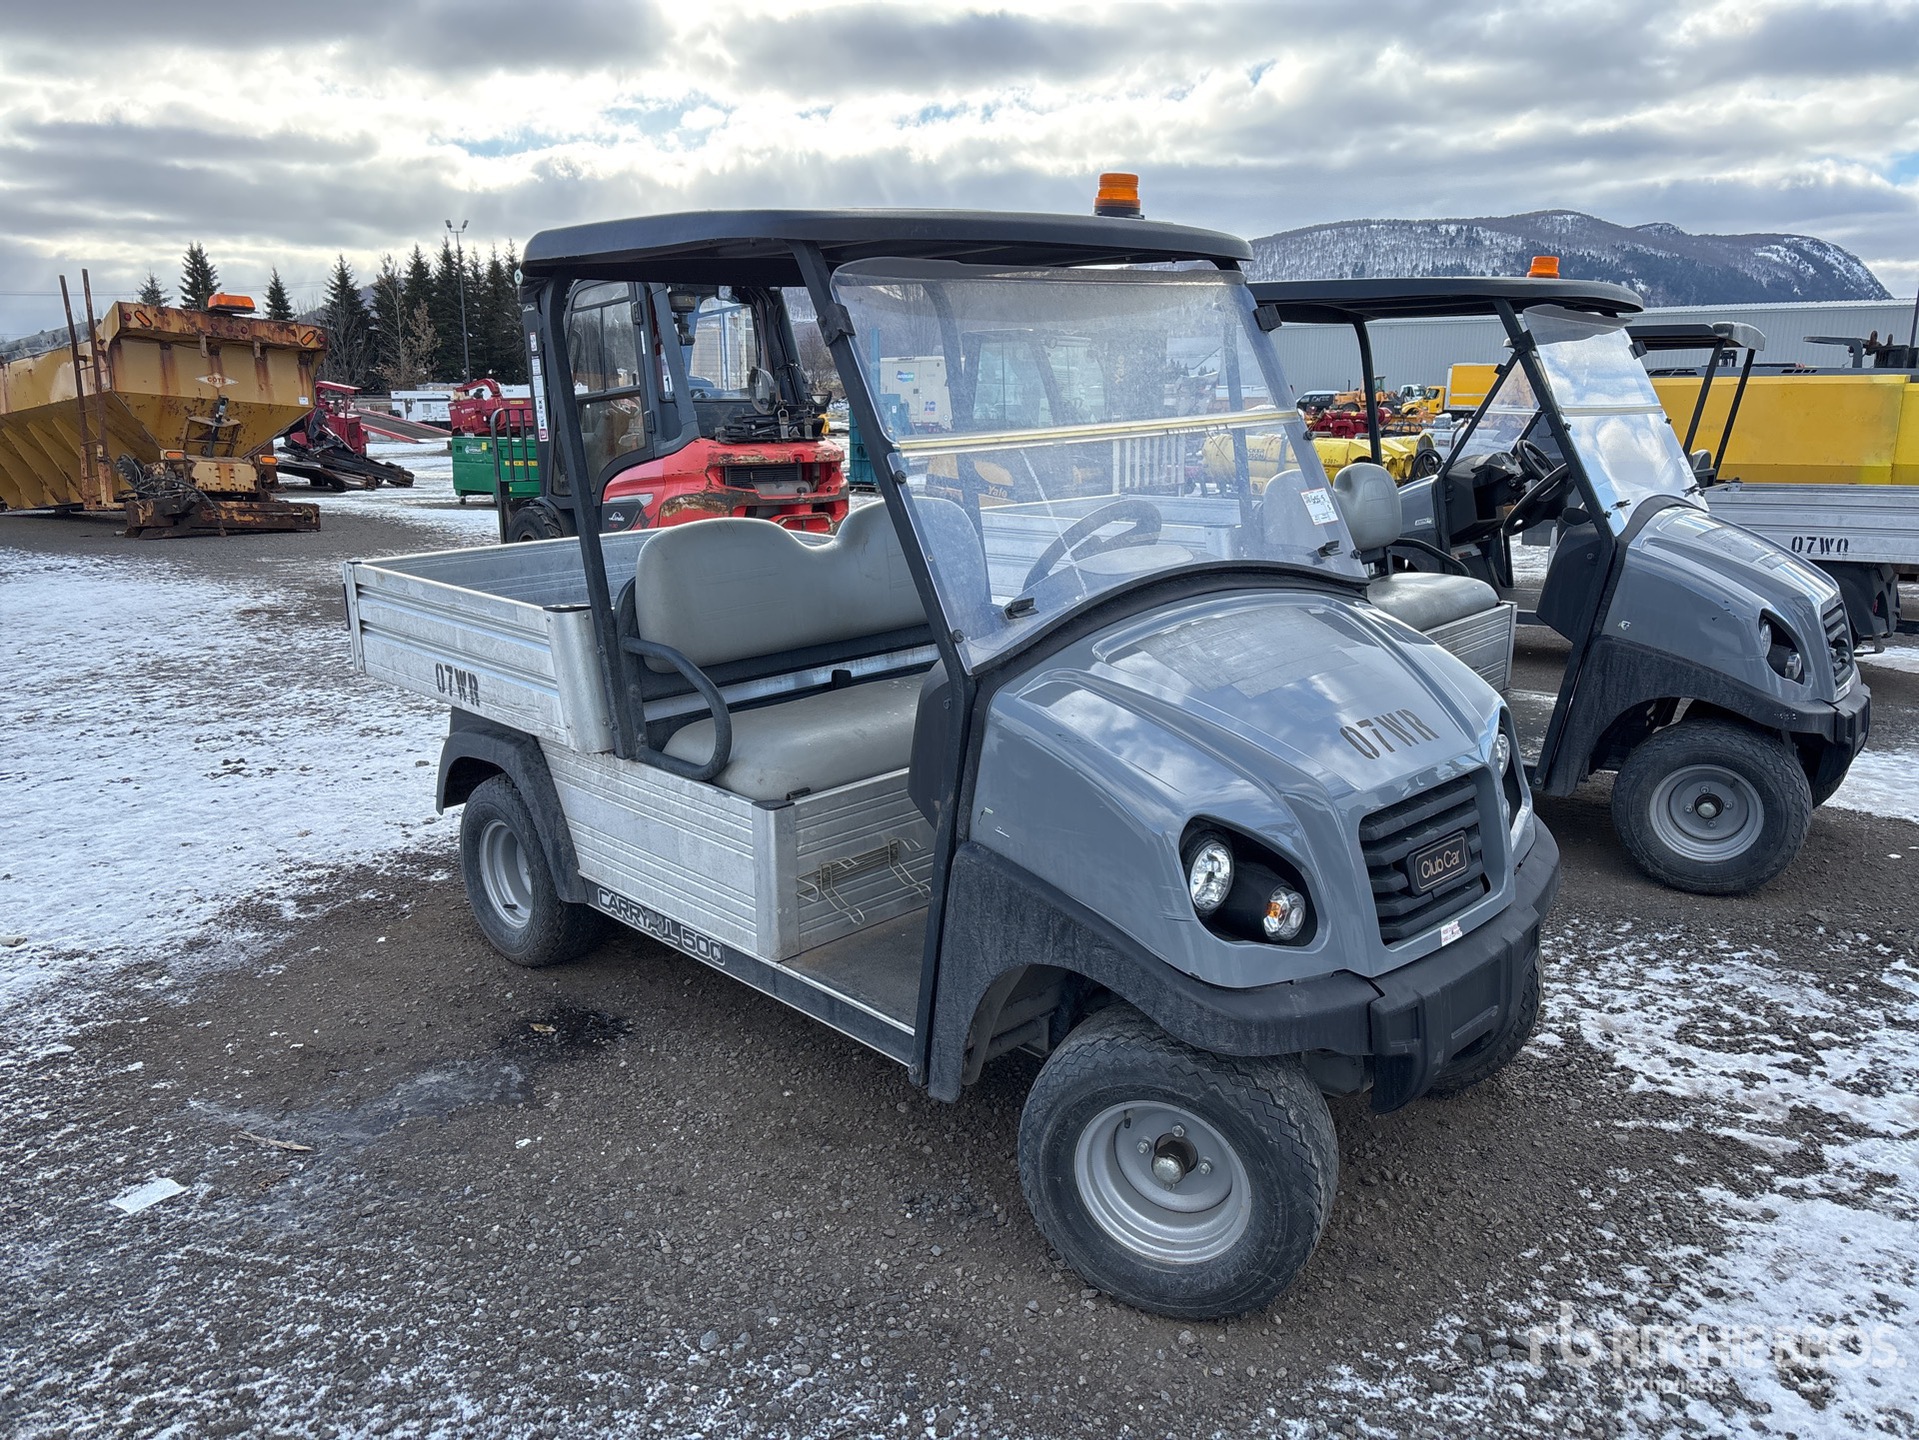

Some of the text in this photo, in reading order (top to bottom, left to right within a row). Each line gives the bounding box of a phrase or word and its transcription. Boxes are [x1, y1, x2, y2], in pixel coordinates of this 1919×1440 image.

[988, 485, 1008, 498] Yale
[435, 662, 480, 707] 07WR
[1340, 708, 1440, 760] 07WR
[1421, 850, 1460, 879] Club Car
